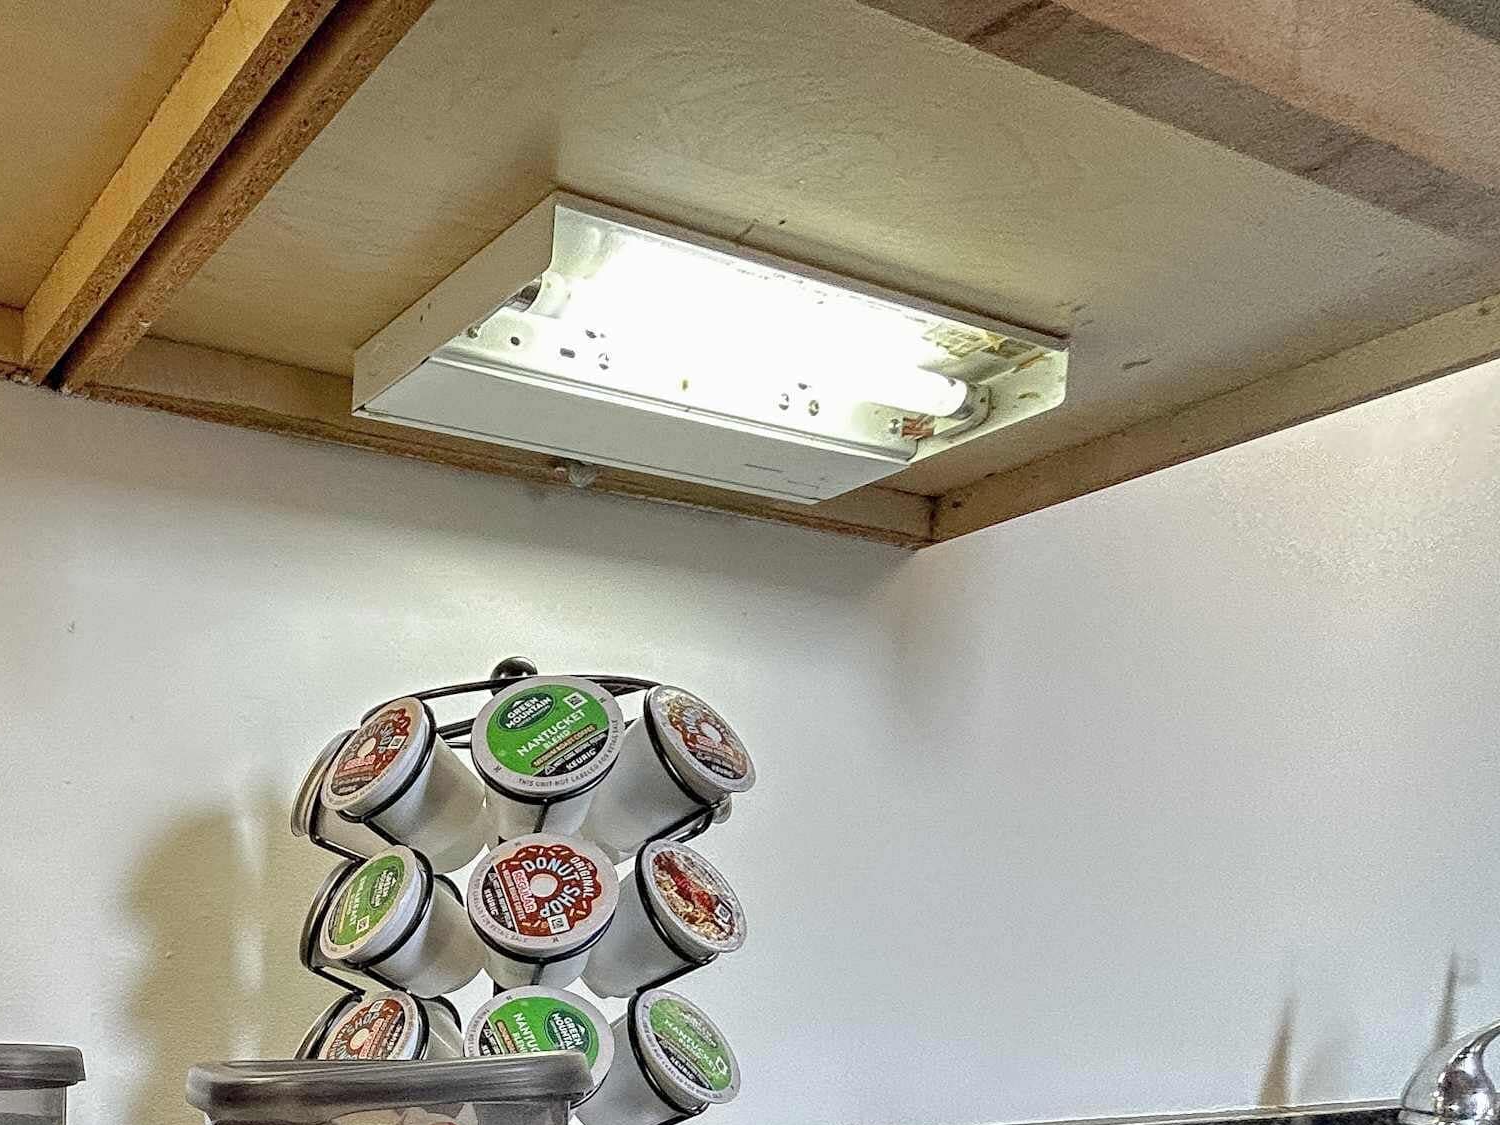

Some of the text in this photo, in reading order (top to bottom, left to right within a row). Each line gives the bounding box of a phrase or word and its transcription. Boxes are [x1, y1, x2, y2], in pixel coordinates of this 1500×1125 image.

[506, 697, 552, 729] MOUNTAIN
[507, 697, 540, 719] GREEN
[516, 709, 586, 757] NANTUCKET
[541, 729, 572, 751] BLEND
[565, 748, 597, 771] KEURIG
[512, 869, 538, 914] REGULAR
[521, 857, 581, 919] DONUT SHOP
[570, 856, 595, 898] ORIGINAL
[483, 888, 500, 917] KEURIG
[513, 1012, 541, 1053] NANTUC
[552, 1012, 576, 1050] MOUNTAI
[564, 1016, 585, 1047] GREEN
